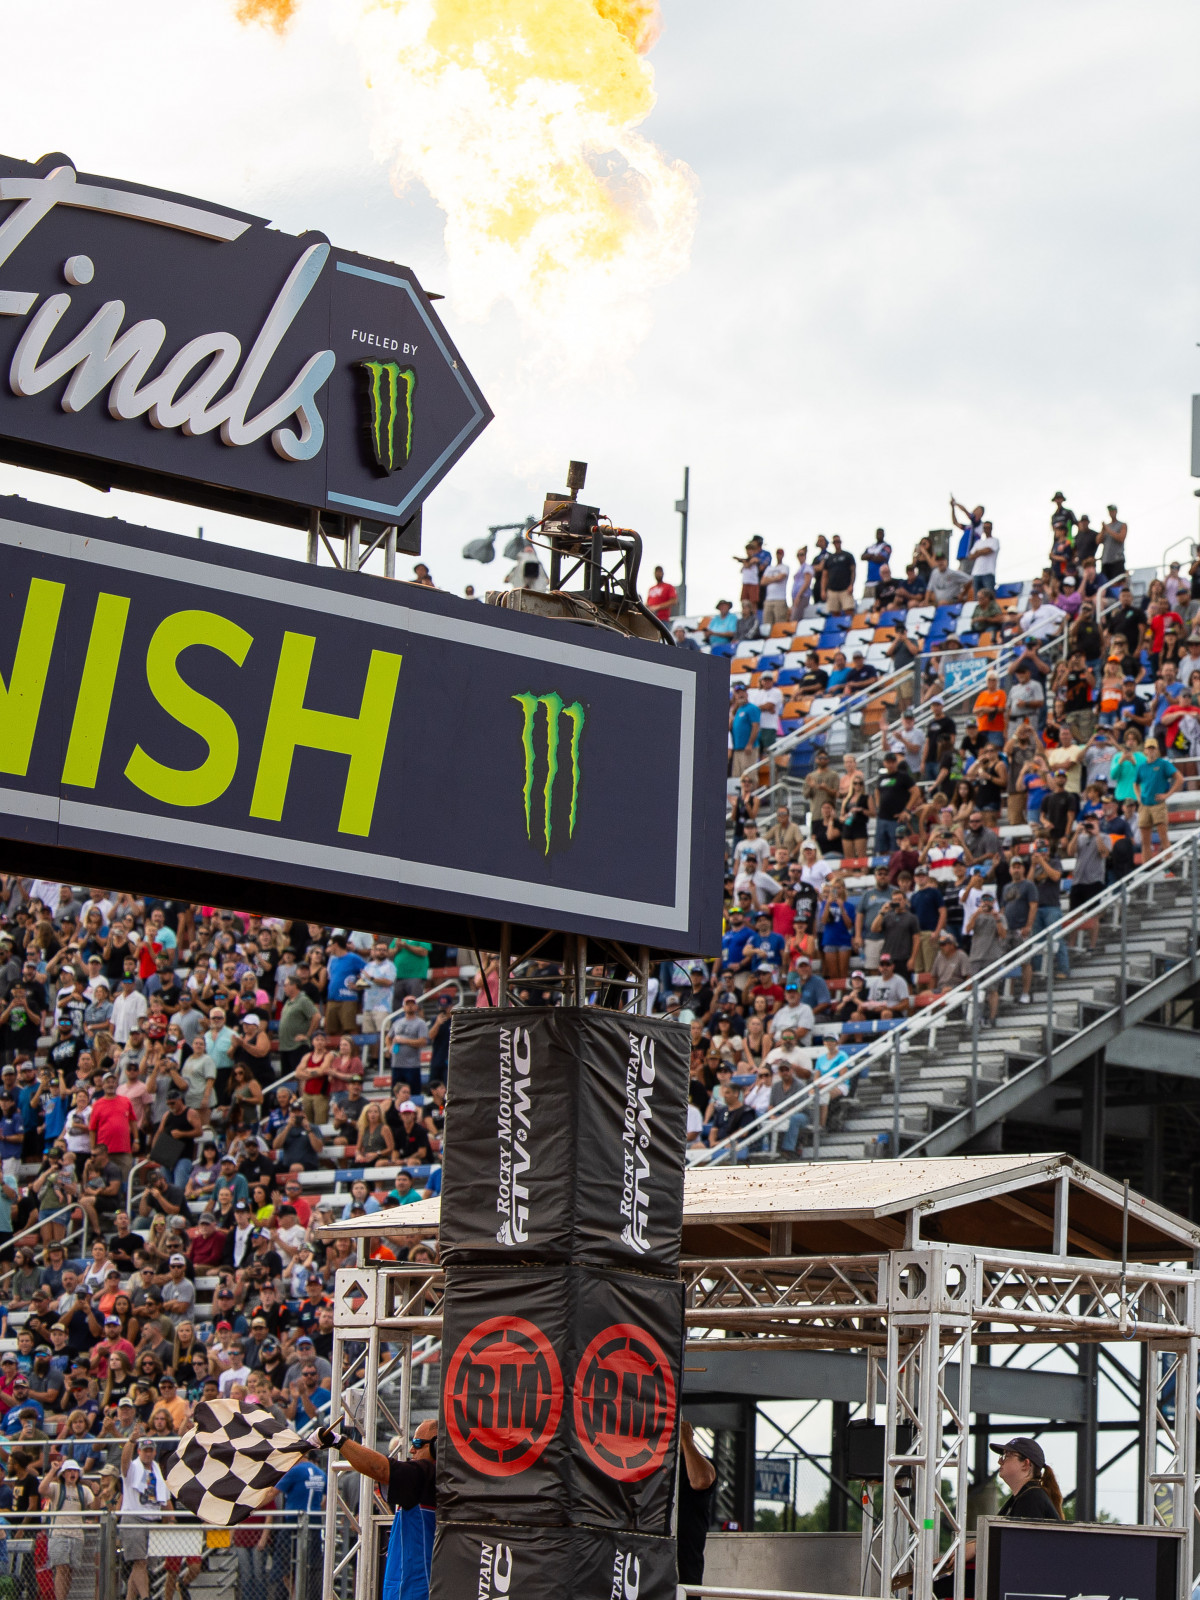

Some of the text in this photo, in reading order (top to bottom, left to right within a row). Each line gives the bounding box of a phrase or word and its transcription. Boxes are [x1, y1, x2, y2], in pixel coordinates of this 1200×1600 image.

[351, 329, 418, 356] FUELED BY
[496, 1027, 512, 1217] ROCKY MOUNTAIN
[620, 1032, 641, 1219] ROCKY MOUNTAIN
[466, 1363, 539, 1429] RM
[592, 1367, 662, 1440] RM
[760, 1473, 786, 1493] W-Y
